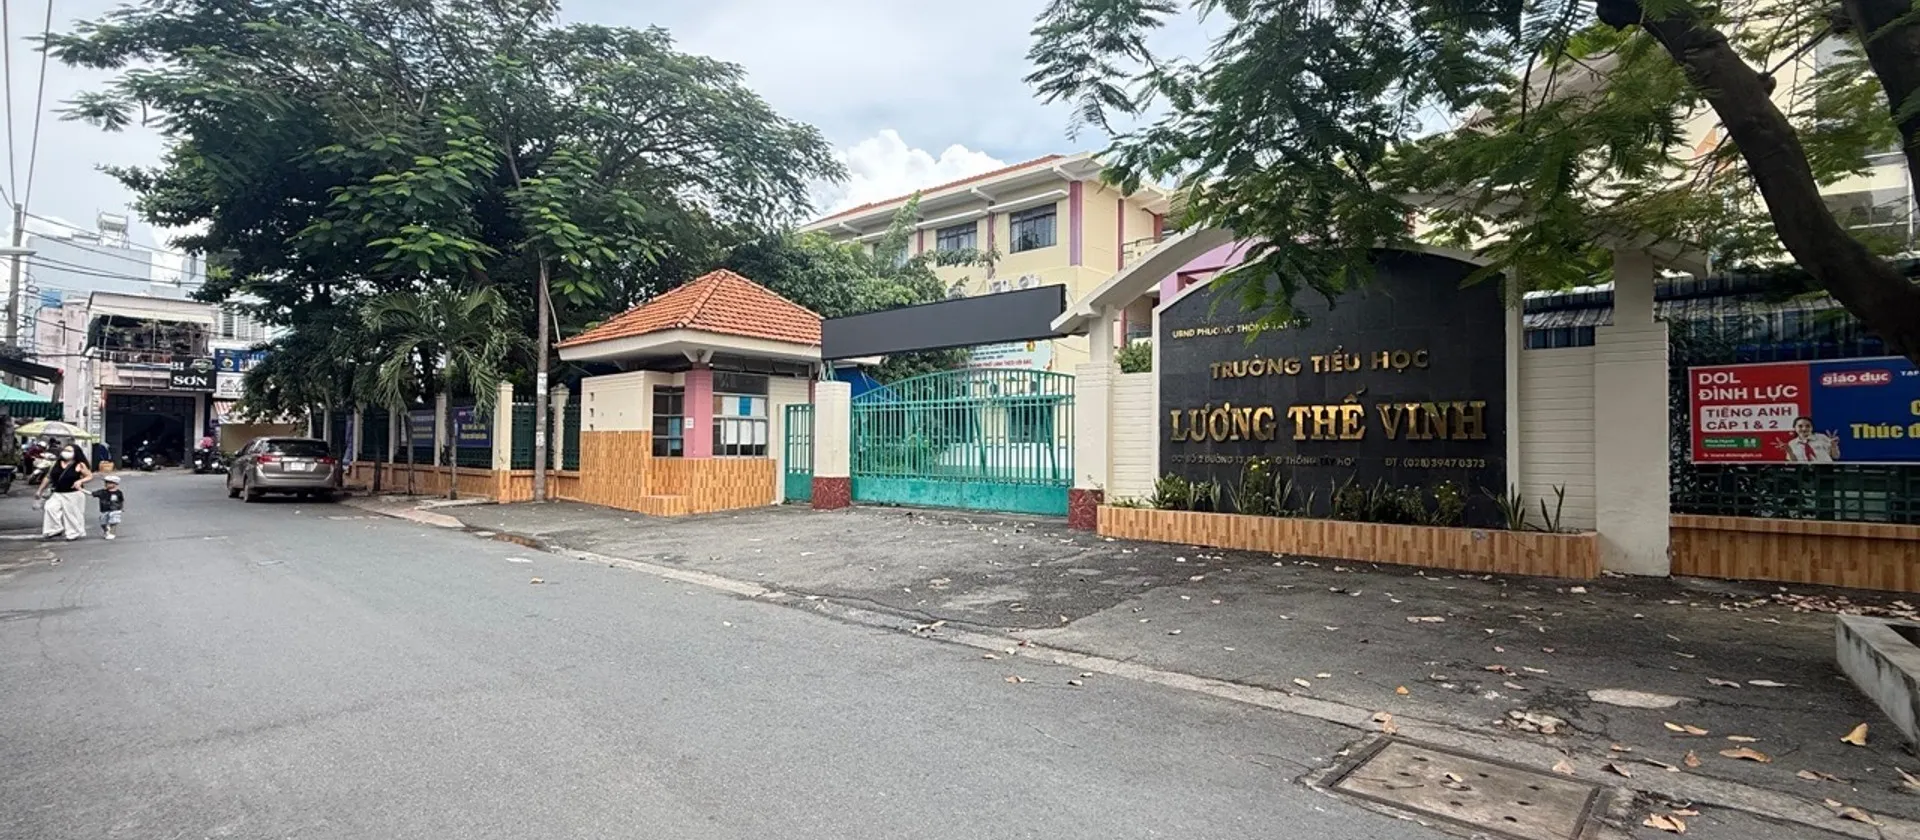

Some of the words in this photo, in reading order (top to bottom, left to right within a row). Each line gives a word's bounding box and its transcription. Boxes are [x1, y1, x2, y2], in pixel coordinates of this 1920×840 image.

[1172, 328, 1195, 339] UBND
[1210, 354, 1302, 379] TRƯỜNG
[1311, 344, 1361, 374] TIỂU
[1371, 349, 1430, 374] HỌC
[173, 374, 208, 386] SƠN
[1699, 372, 1741, 385] DOL
[1822, 371, 1857, 386] giáo
[1859, 371, 1889, 383] dục
[1698, 385, 1748, 401] ĐÌNH
[1754, 384, 1799, 401] LỰC
[1170, 402, 1278, 443] LƯƠNG
[1287, 384, 1367, 442] THẾ
[1376, 401, 1488, 441] VINH
[1706, 406, 1753, 418] TIẾNG
[1757, 406, 1792, 417] ANH
[1706, 418, 1739, 430] CẤP
[1742, 421, 1748, 430] 1
[1753, 420, 1764, 430] &
[1769, 420, 1779, 429] 2
[1850, 422, 1904, 439] Thúc
[1458, 458, 1486, 468] 0373
